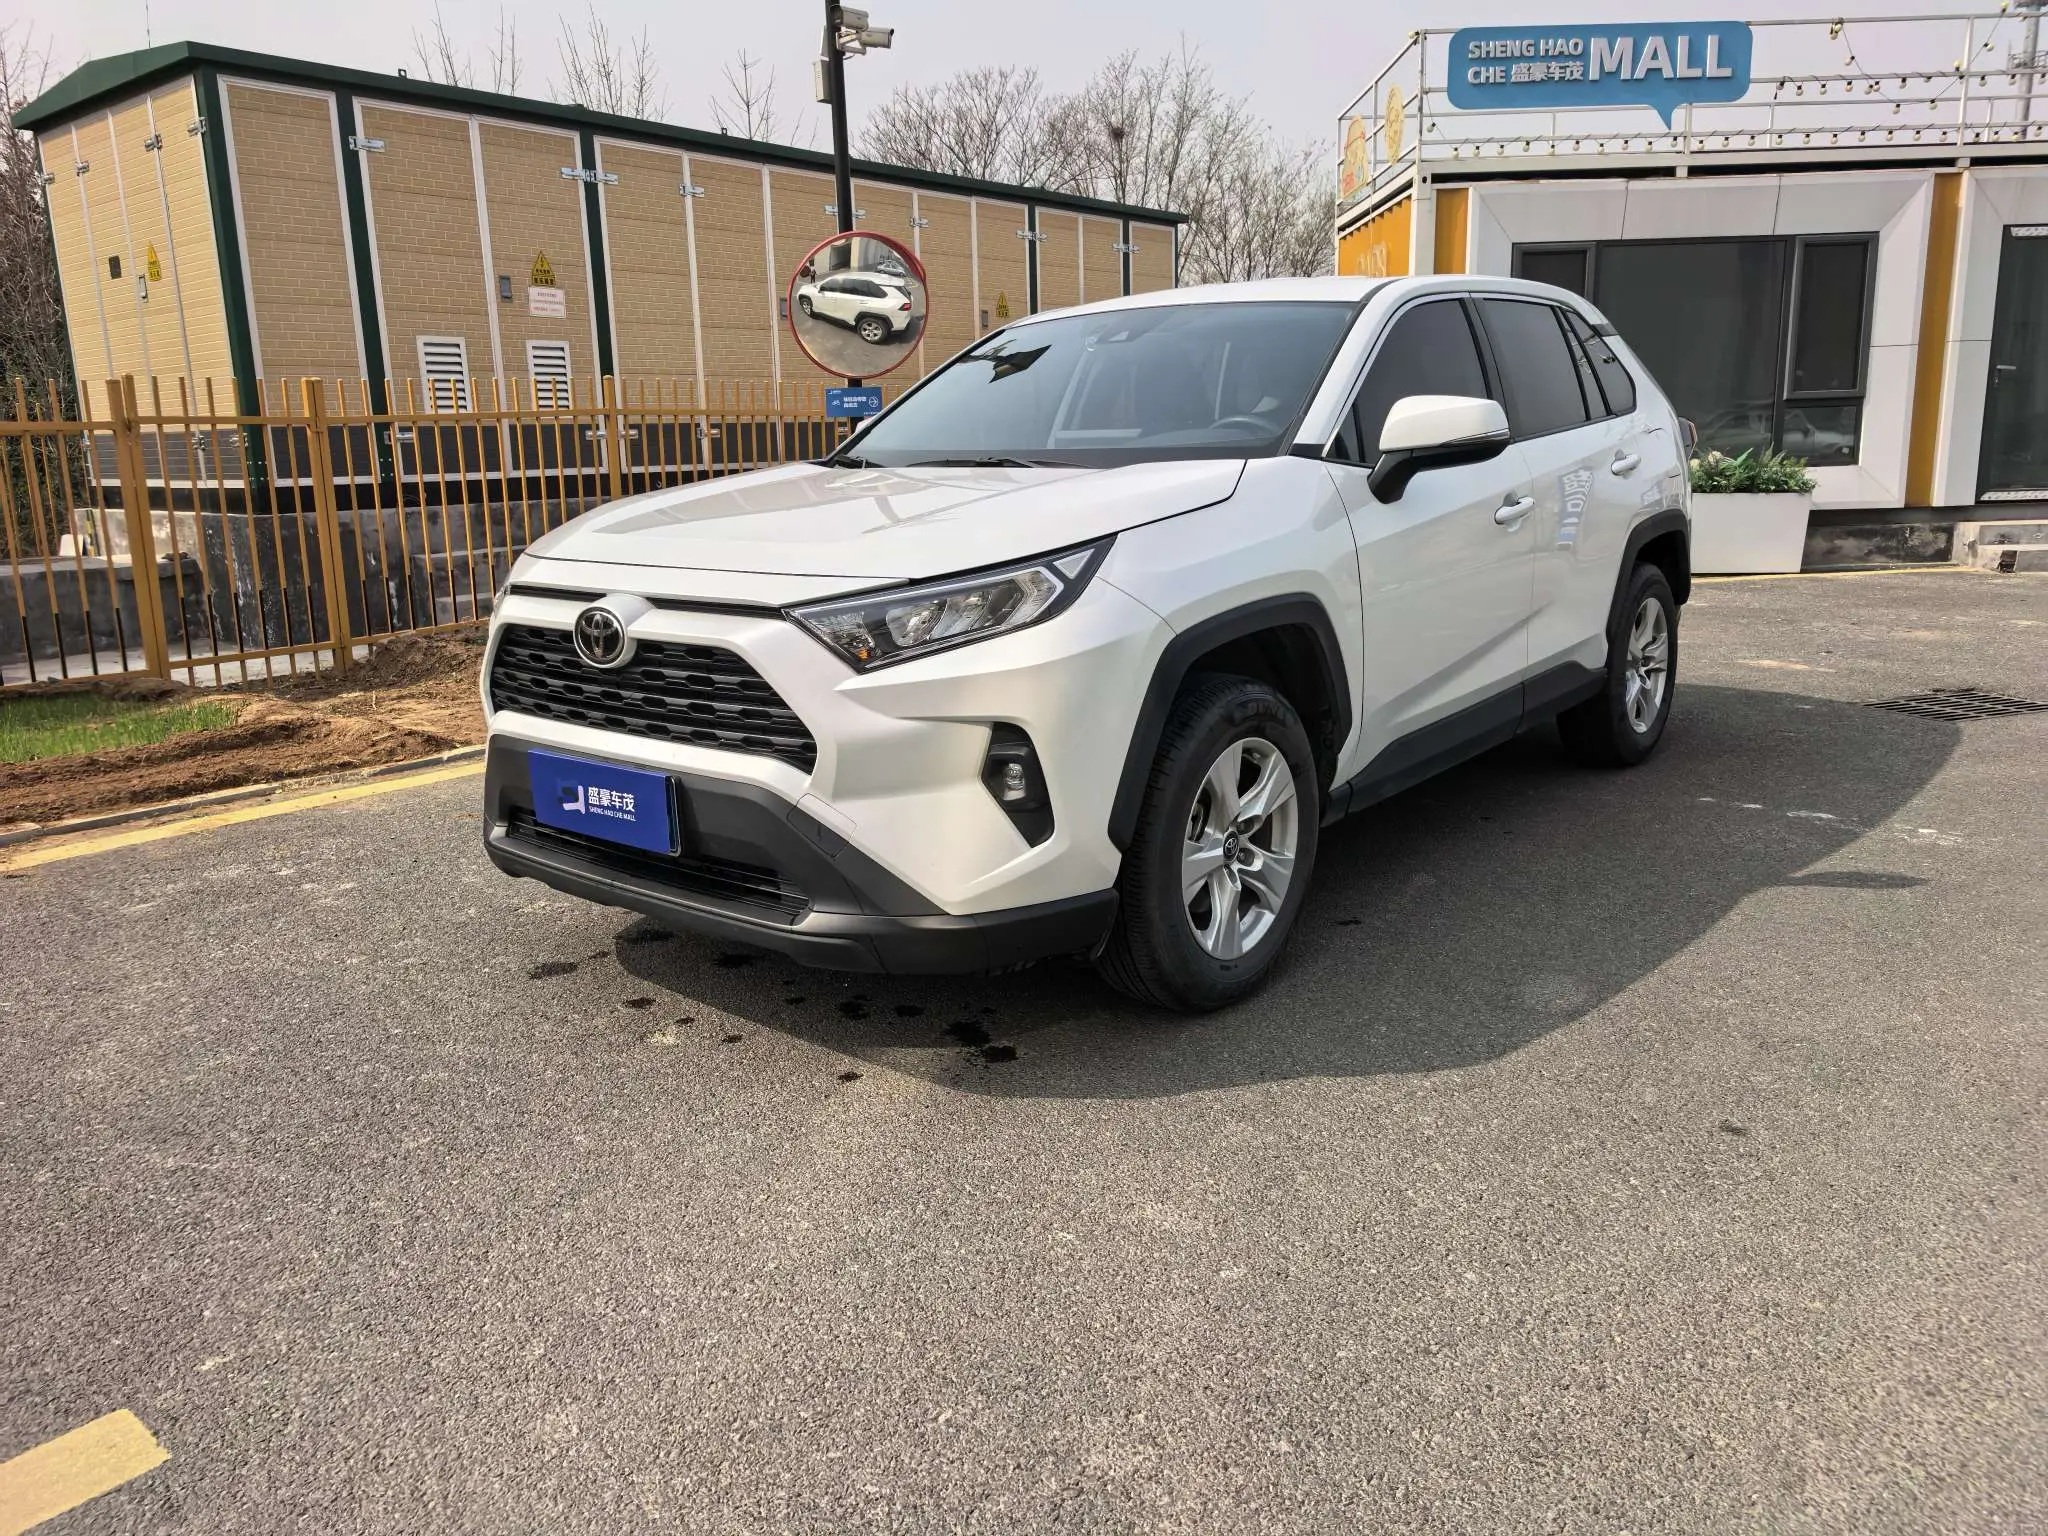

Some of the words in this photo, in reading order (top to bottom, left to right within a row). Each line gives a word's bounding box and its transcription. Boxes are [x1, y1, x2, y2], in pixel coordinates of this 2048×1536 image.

[1468, 39, 1534, 59] SHENG
[1540, 38, 1584, 57] HAO
[1588, 34, 1733, 82] MALL
[1467, 65, 1506, 85] CHE
[1511, 61, 1584, 83] 盛豪车茂
[588, 787, 635, 812] 盛豪车茂
[623, 813, 636, 822] MALL
